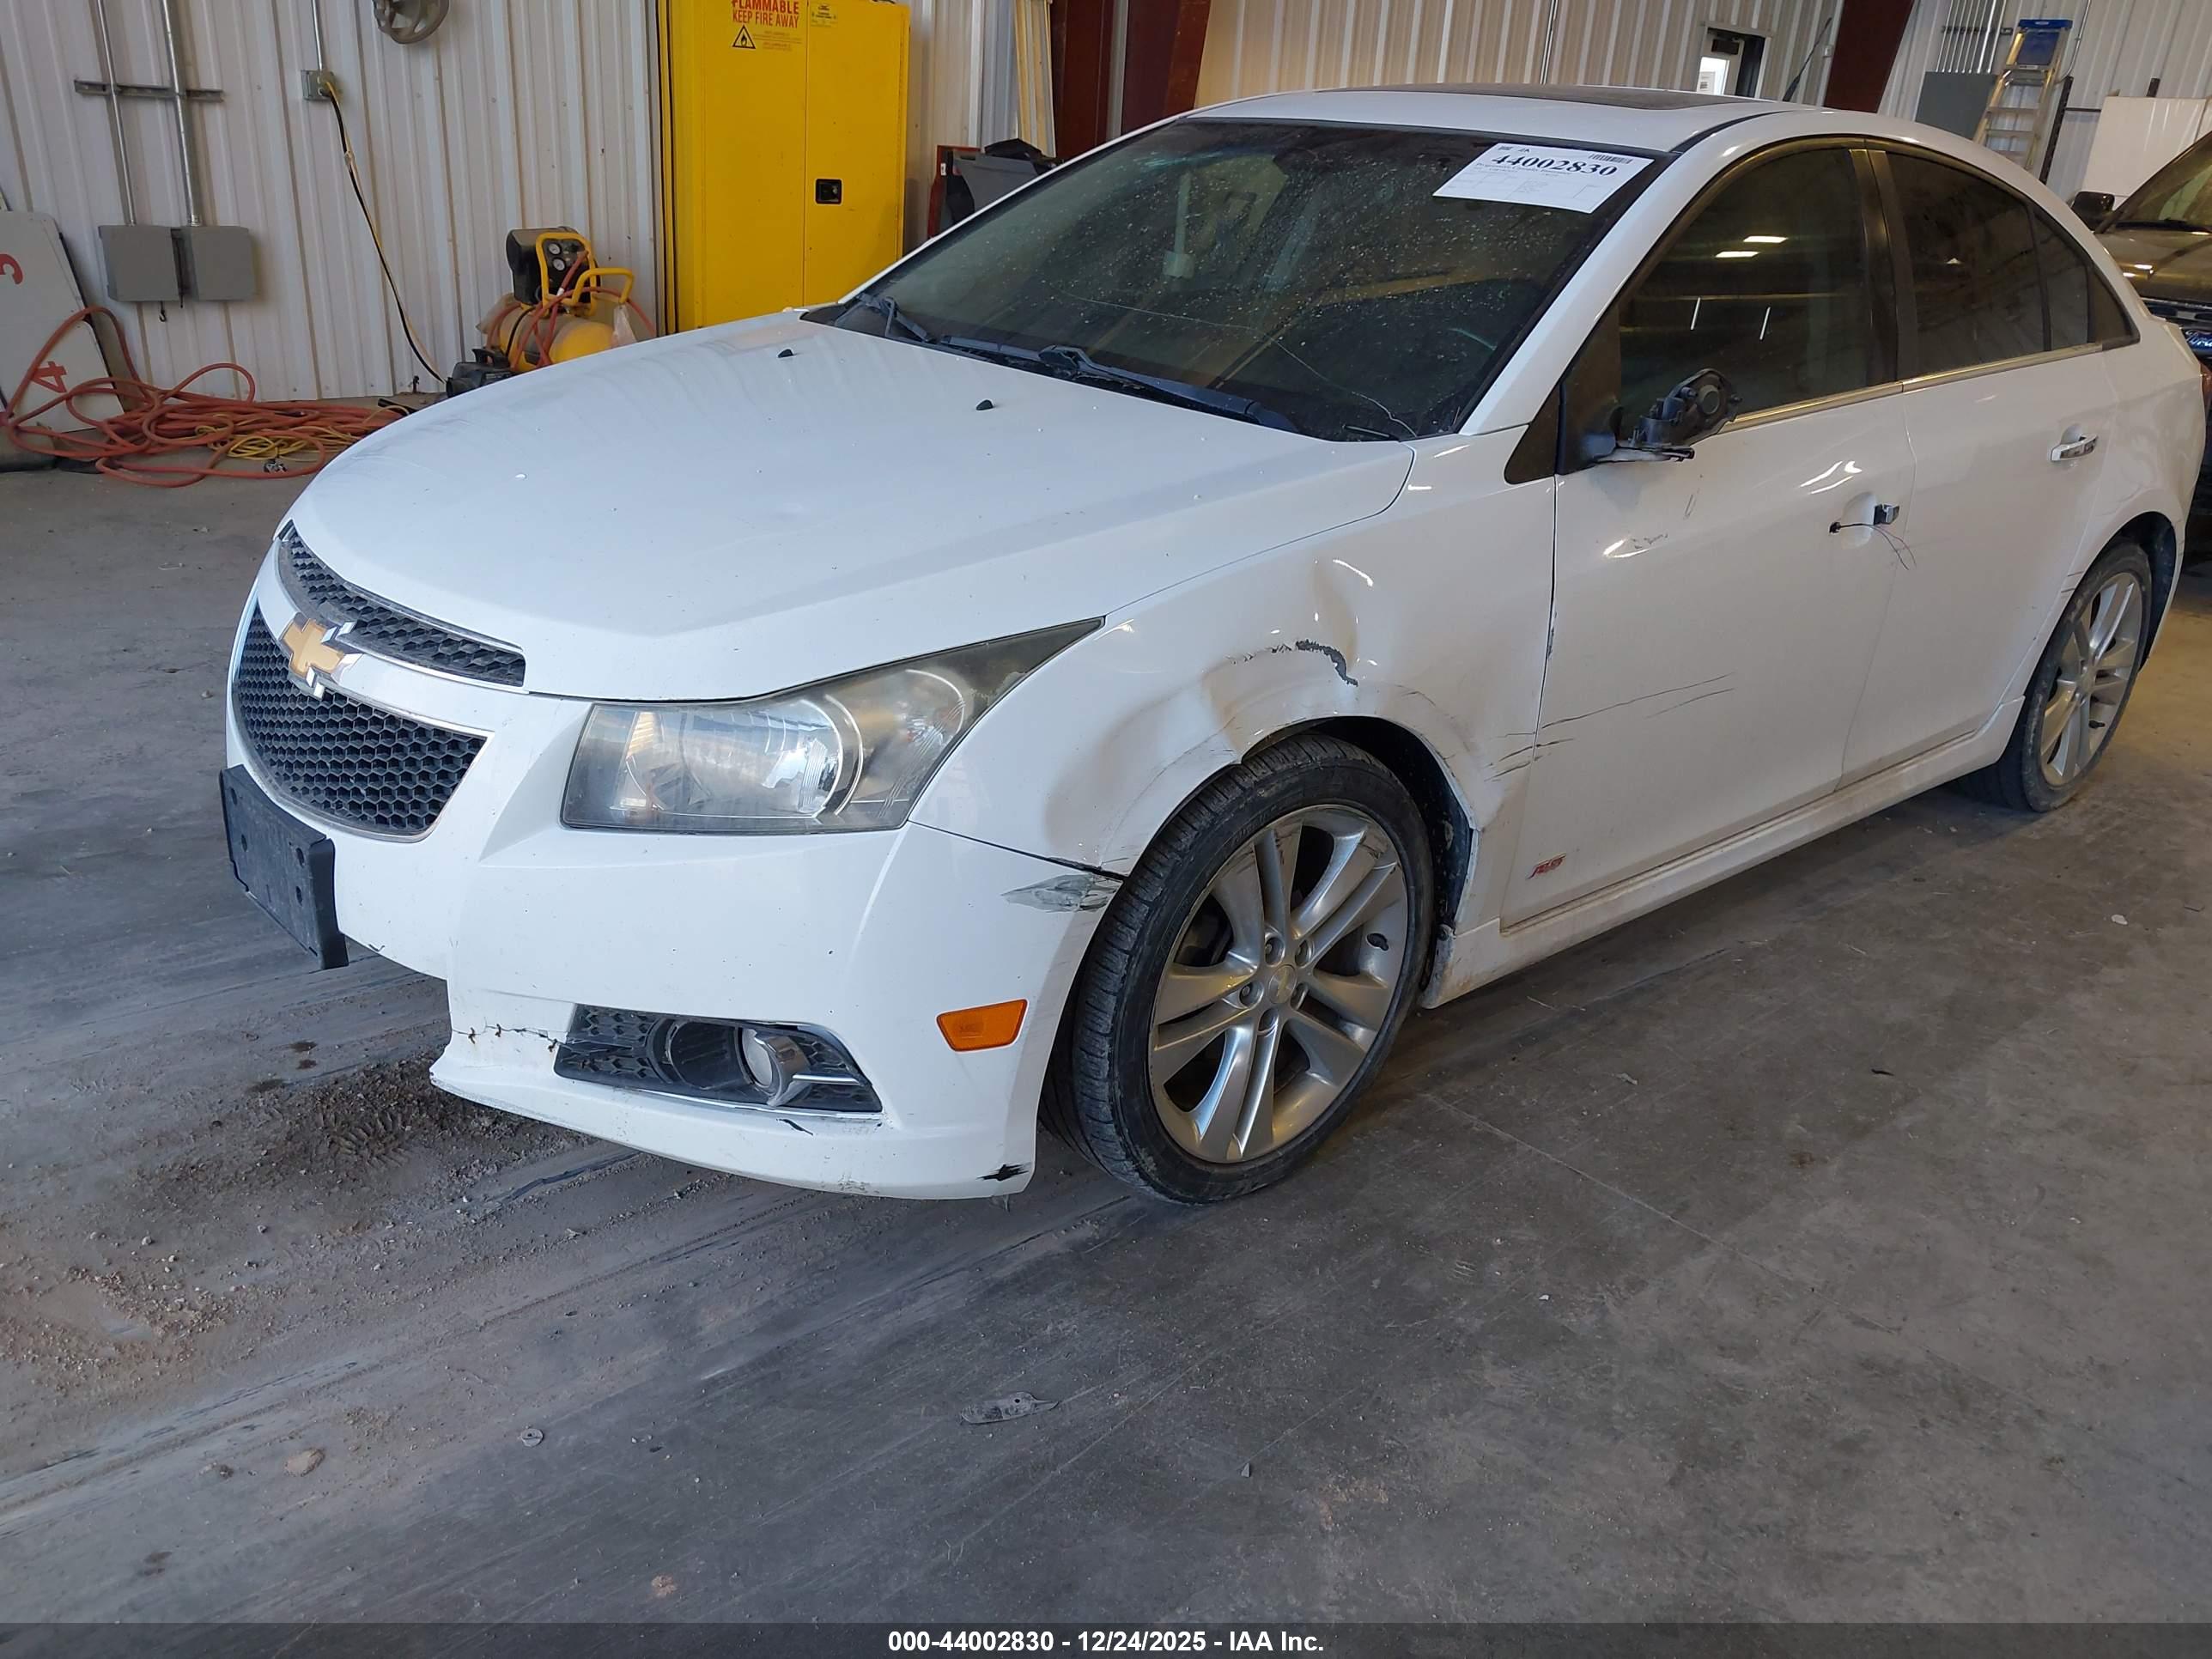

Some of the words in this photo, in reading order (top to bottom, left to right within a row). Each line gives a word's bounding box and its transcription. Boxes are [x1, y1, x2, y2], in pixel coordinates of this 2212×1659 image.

[732, 9, 752, 23] KEEP
[755, 11, 774, 26] FIRE
[775, 15, 799, 28] AWAY
[1492, 155, 1618, 176] 44002830
